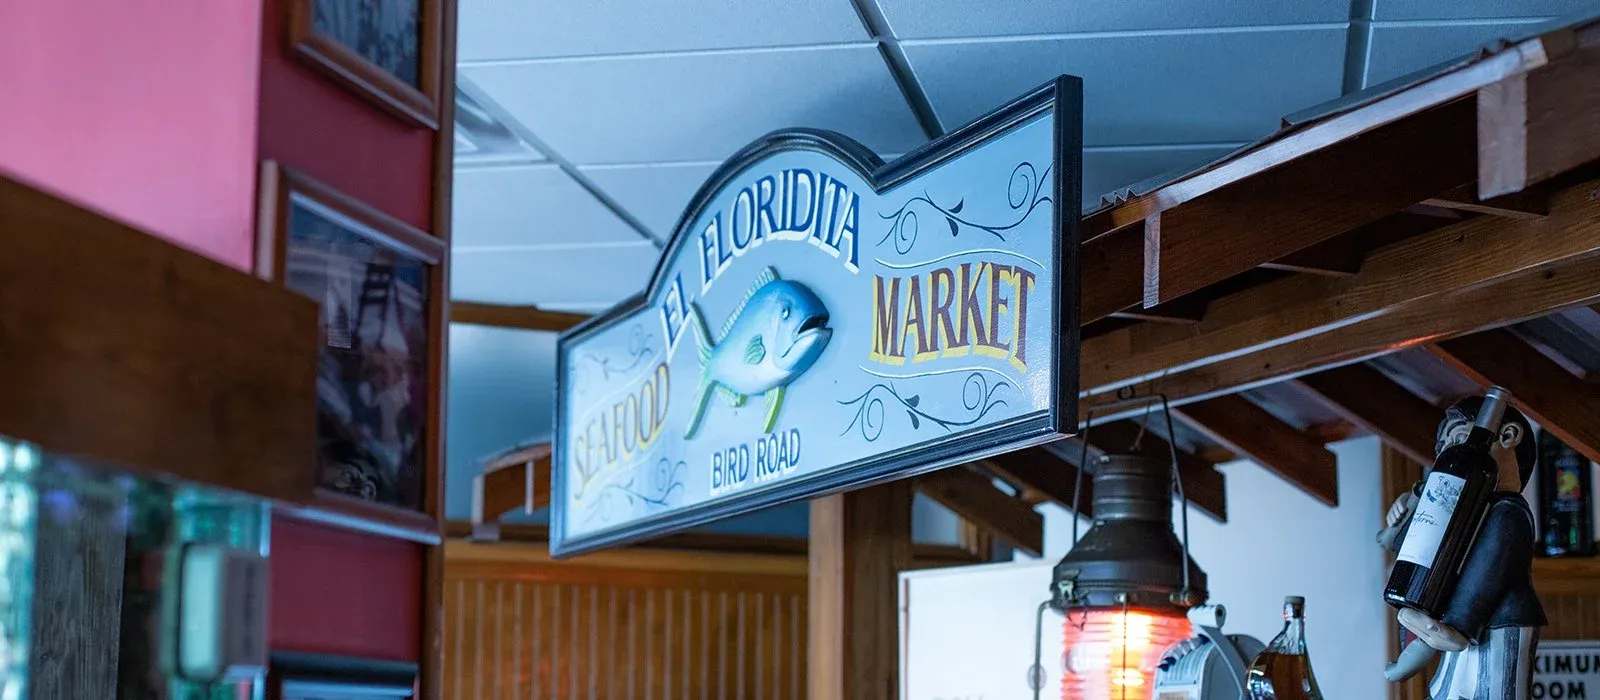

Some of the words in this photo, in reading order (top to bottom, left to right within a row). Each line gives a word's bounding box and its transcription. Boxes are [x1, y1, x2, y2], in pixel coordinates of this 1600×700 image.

[661, 271, 692, 359] EL
[699, 168, 860, 295] FLORIDITA
[870, 261, 1036, 372] MARKET
[573, 362, 670, 502] SEAFOOD
[711, 443, 749, 493] BIRD
[755, 428, 800, 480] ROAD
